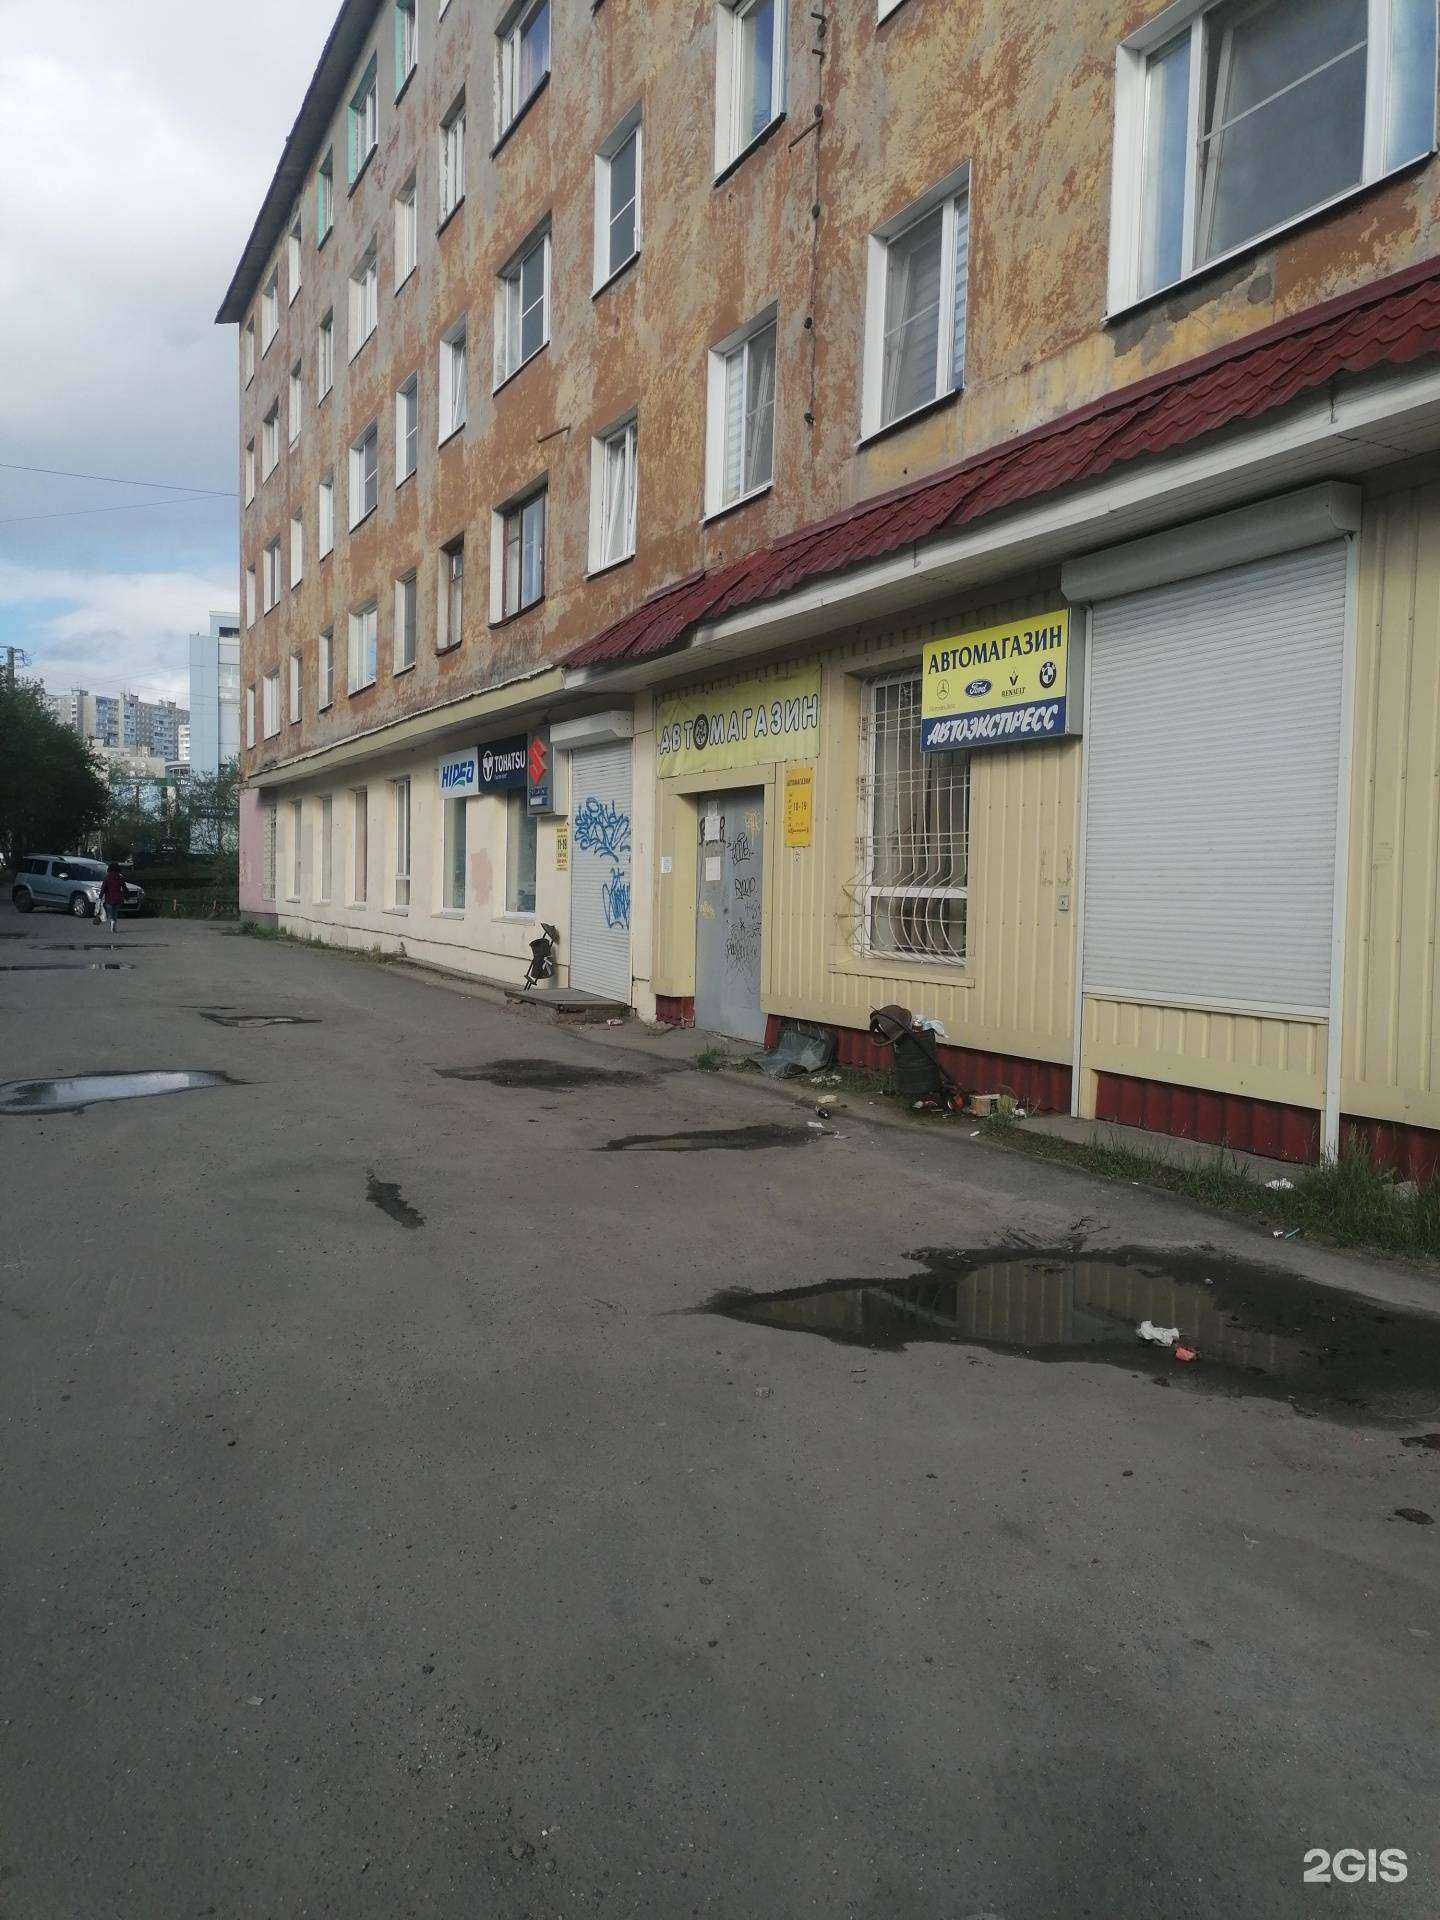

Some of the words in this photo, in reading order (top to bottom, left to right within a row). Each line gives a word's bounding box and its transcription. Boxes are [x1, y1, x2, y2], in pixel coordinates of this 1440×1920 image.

[928, 624, 1062, 675] АВТОМАГАЗИН
[969, 682, 988, 695] Ford
[659, 693, 819, 755] АВТОМАГАЗИН
[926, 704, 1059, 746] АВТОЭКСПРЕСС
[495, 749, 526, 773] TOHATSU
